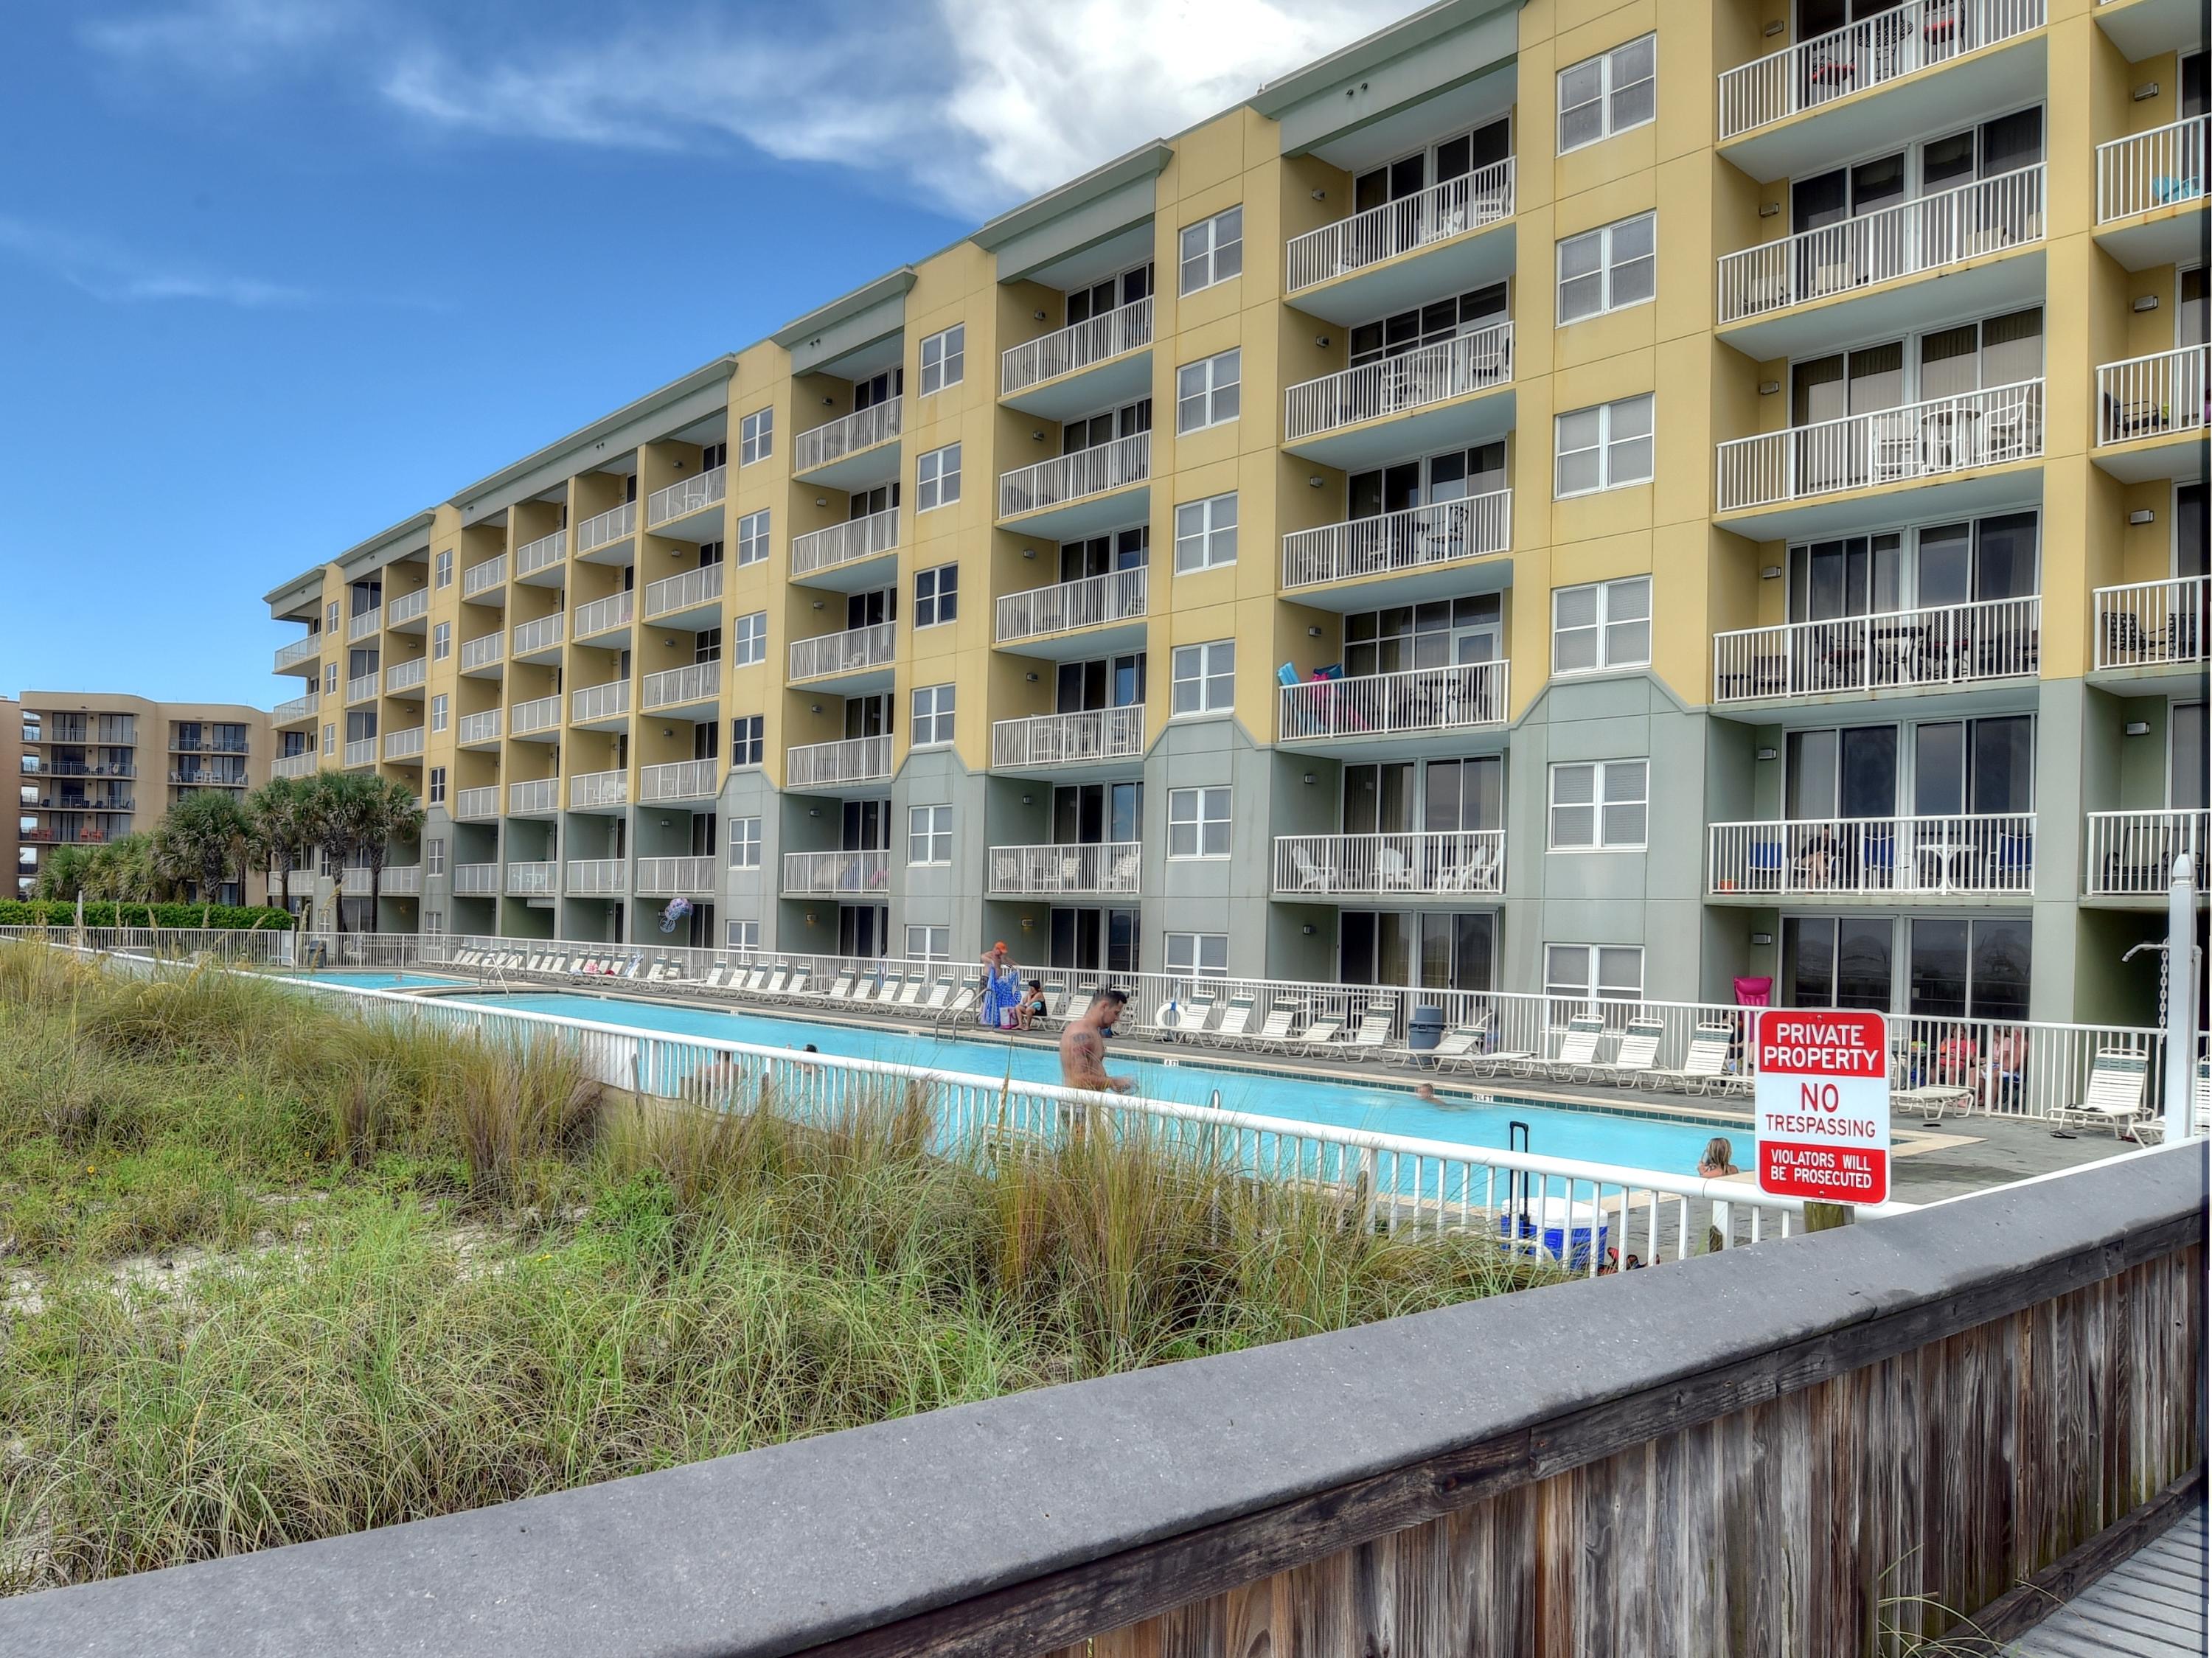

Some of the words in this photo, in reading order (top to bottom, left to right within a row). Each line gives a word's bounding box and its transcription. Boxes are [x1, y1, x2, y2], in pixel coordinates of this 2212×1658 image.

[1776, 1023, 1865, 1046] PRIVATE
[1764, 1045, 1879, 1071] PROPERTY
[1801, 1082, 1839, 1113] NO
[1765, 1114, 1876, 1138] TRESPASSING
[1771, 1149, 1835, 1168] VIOLATORS
[1842, 1154, 1872, 1171] WILL
[1770, 1166, 1787, 1181] BE
[1794, 1168, 1873, 1189] PROSECUTED
